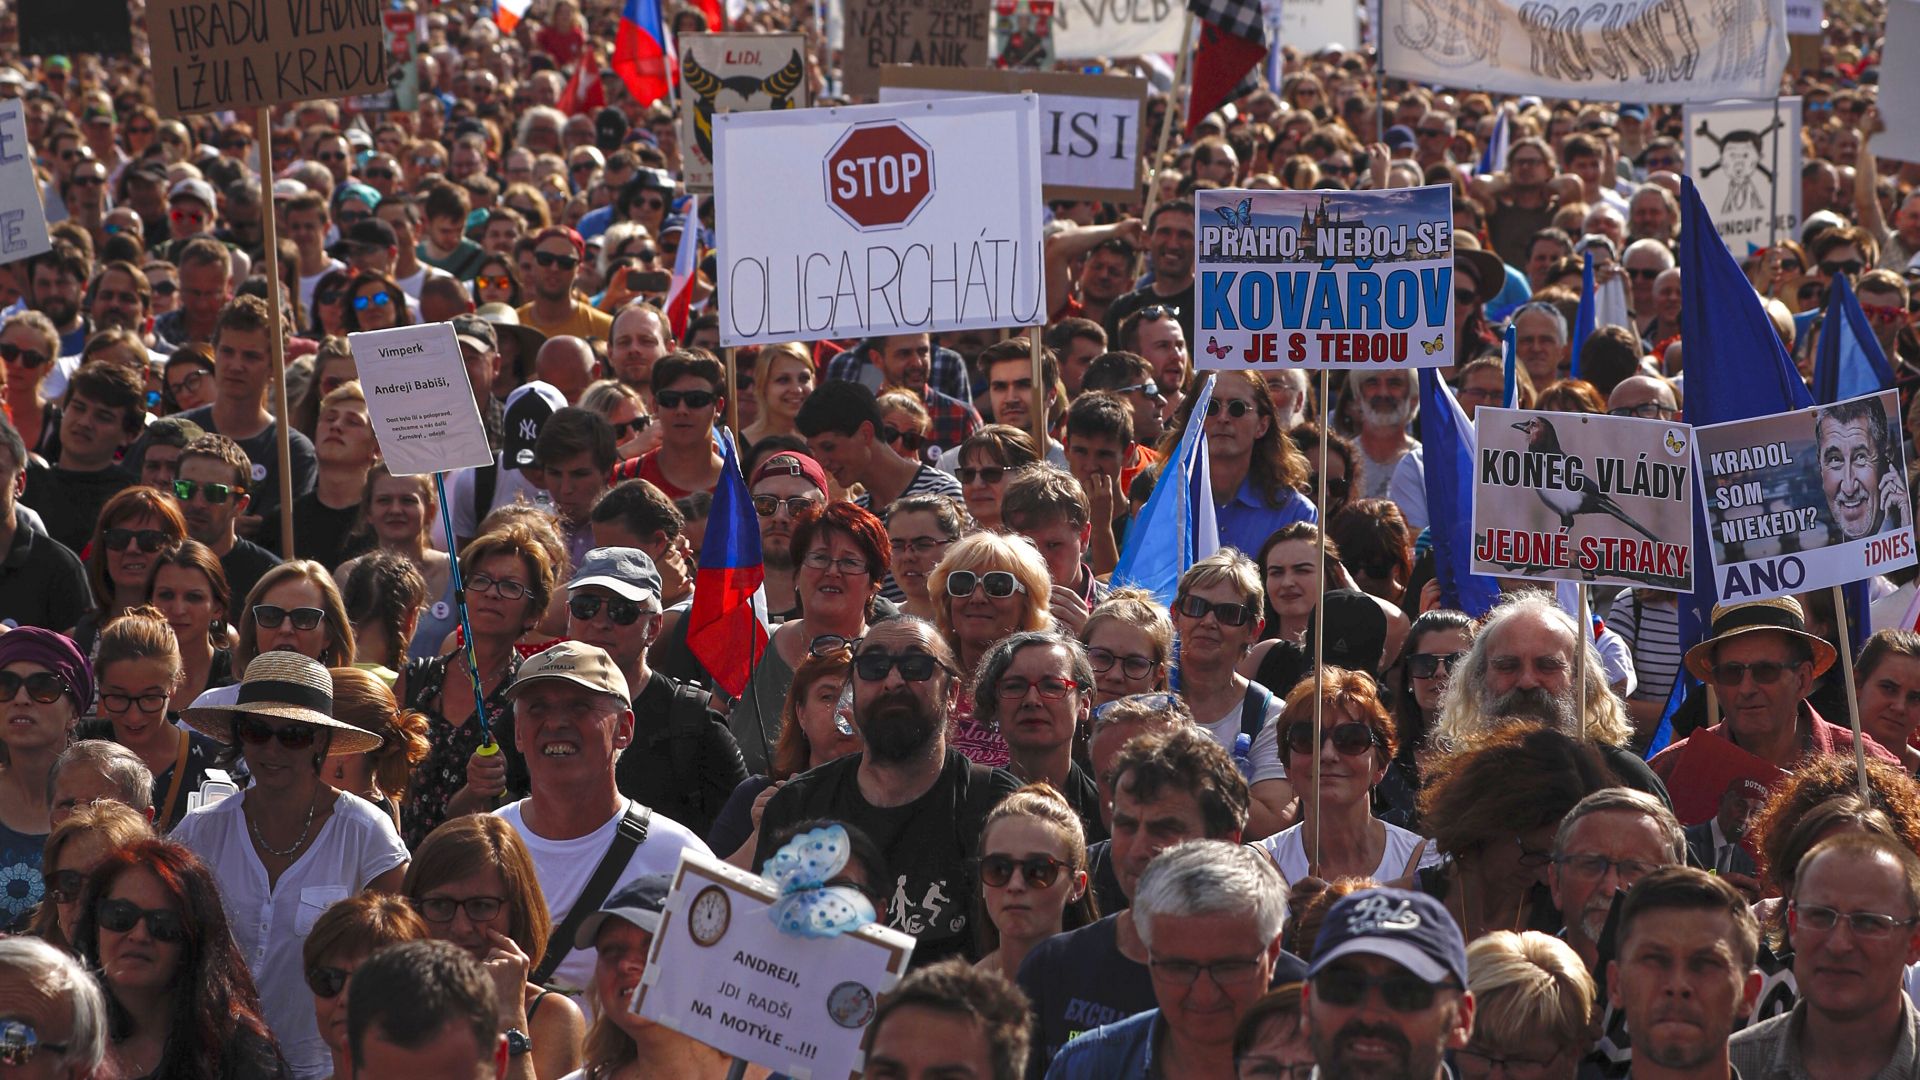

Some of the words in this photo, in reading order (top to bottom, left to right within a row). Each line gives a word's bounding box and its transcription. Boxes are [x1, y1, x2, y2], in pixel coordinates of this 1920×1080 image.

[169, 0, 268, 53] HRADU
[243, 57, 263, 100] A
[275, 41, 386, 98] KRADU
[836, 152, 922, 200] STOP
[1202, 225, 1305, 260] PRAHO,
[1316, 224, 1408, 258] NEBOJ
[1415, 221, 1450, 255] SE
[730, 228, 1042, 337] OLIGARCHÁTU
[1201, 258, 1452, 331] KOVÁŘOV
[378, 343, 424, 358] Vimperk
[1243, 333, 1278, 363] JE
[1287, 333, 1307, 363] S
[1316, 332, 1408, 363] TEBOU
[375, 382, 412, 395] Andreji
[415, 377, 450, 390] Babiši,
[1481, 448, 1585, 493] KONEC
[1595, 452, 1688, 502] VLÁDY
[1710, 442, 1793, 476] KRADOL
[1715, 481, 1764, 510] SOM
[1721, 506, 1818, 544] NIEKEDY?
[1477, 526, 1570, 568] JEDNÉ
[1579, 535, 1689, 579] STRAKY
[1723, 555, 1806, 600] ANO
[733, 950, 801, 988] ANDREJI,
[717, 981, 740, 1001] JDI
[747, 990, 793, 1020] RADŠI
[690, 1000, 713, 1019] NA
[720, 1011, 784, 1048] MOTÝLE
